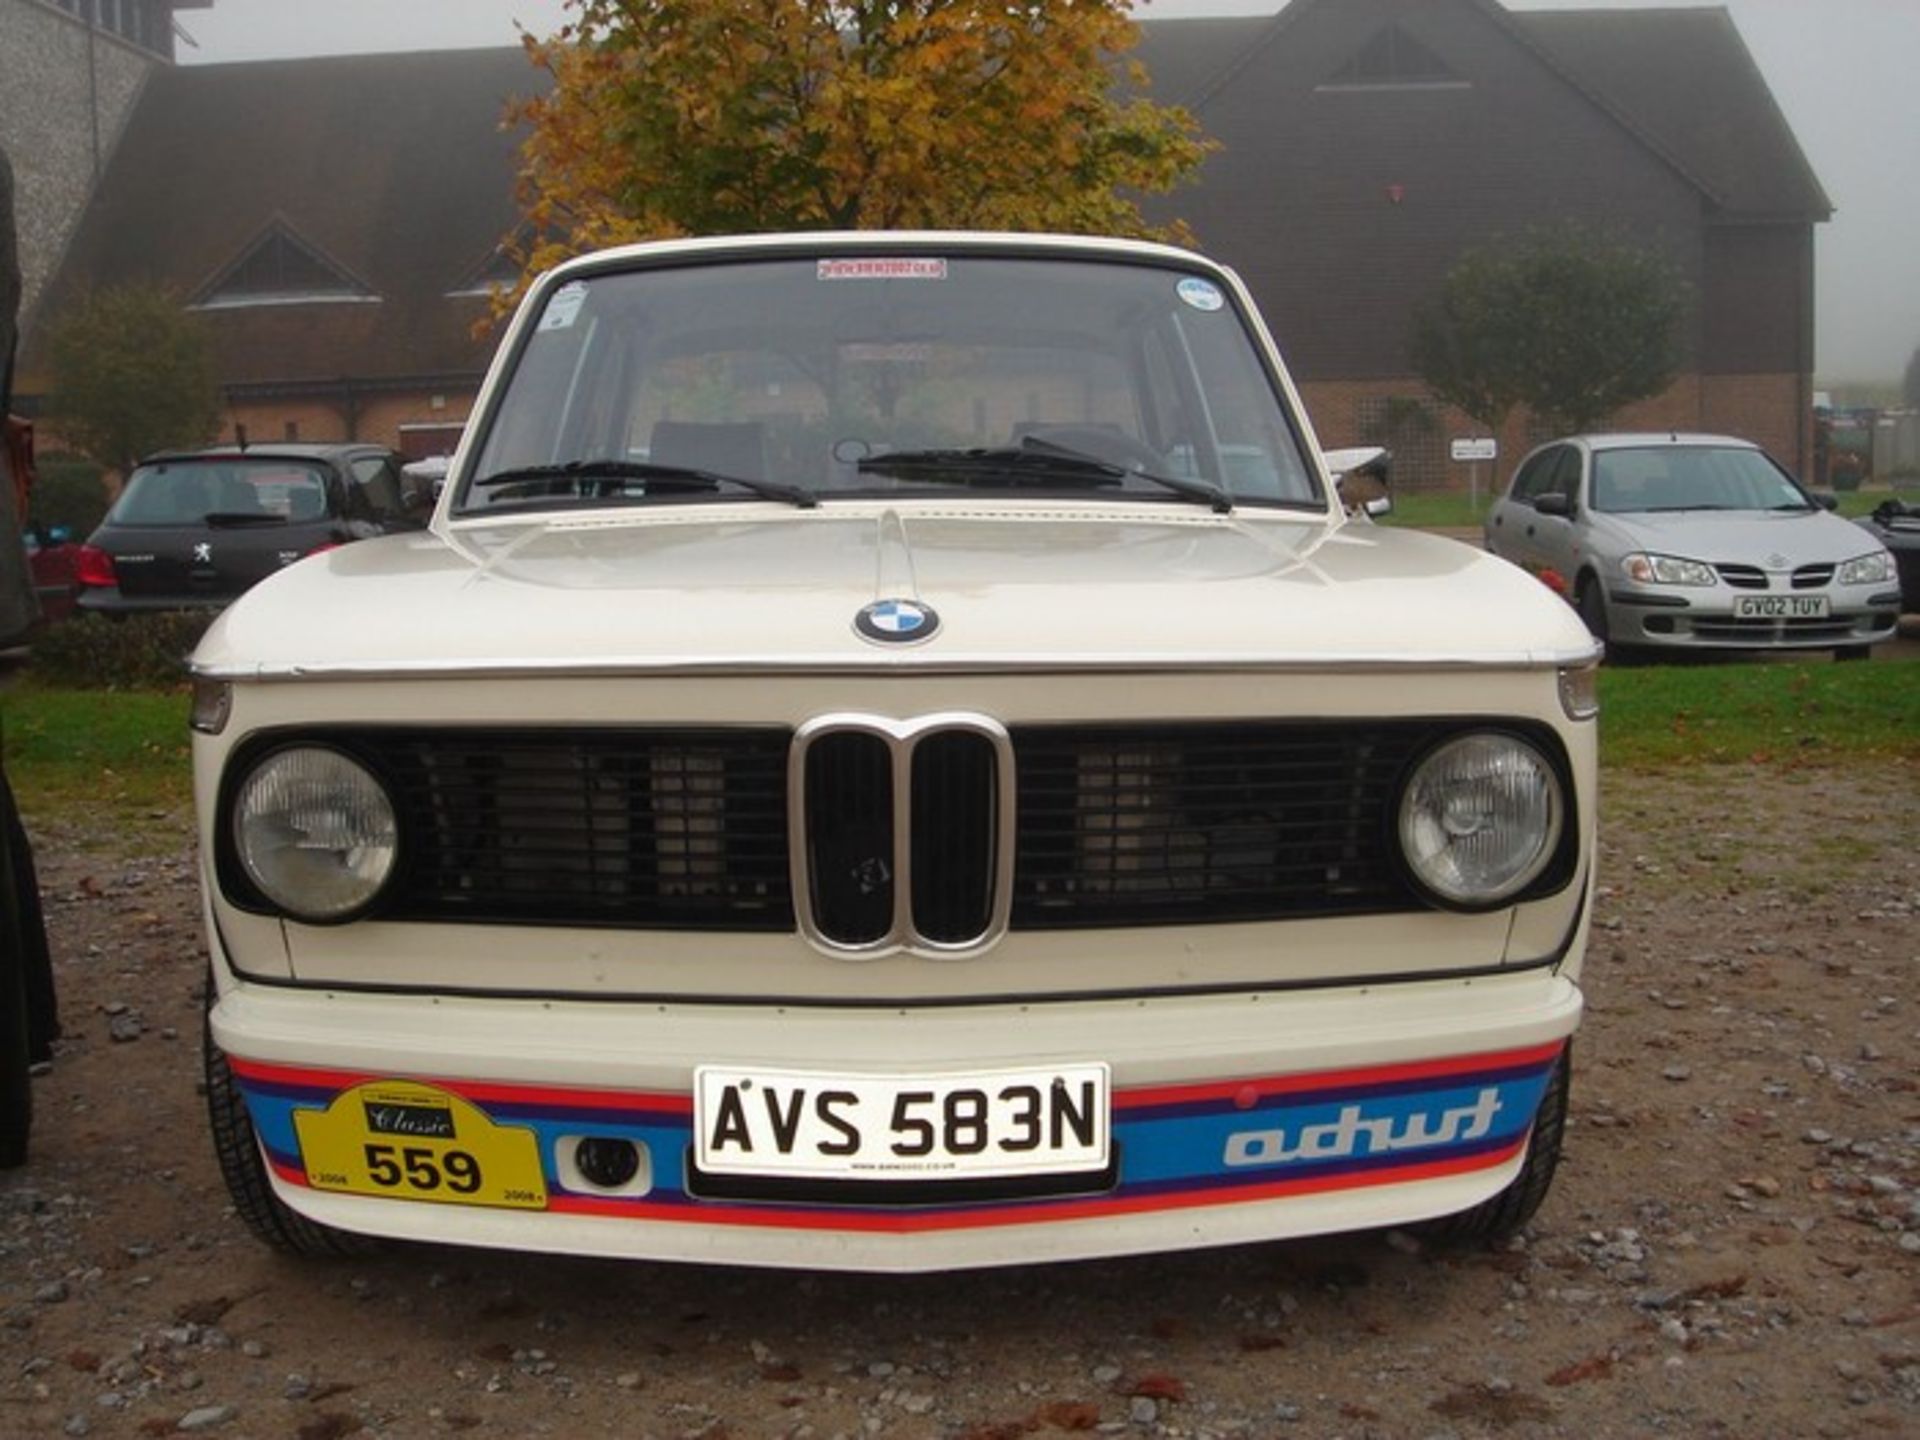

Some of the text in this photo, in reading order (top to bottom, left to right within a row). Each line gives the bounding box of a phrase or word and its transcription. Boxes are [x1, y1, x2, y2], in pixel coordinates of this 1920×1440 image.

[1741, 598, 1822, 615] GV02 TUY
[370, 1106, 451, 1134] Classic
[710, 1080, 1095, 1156] AVS 583N
[364, 1143, 482, 1194] 559
